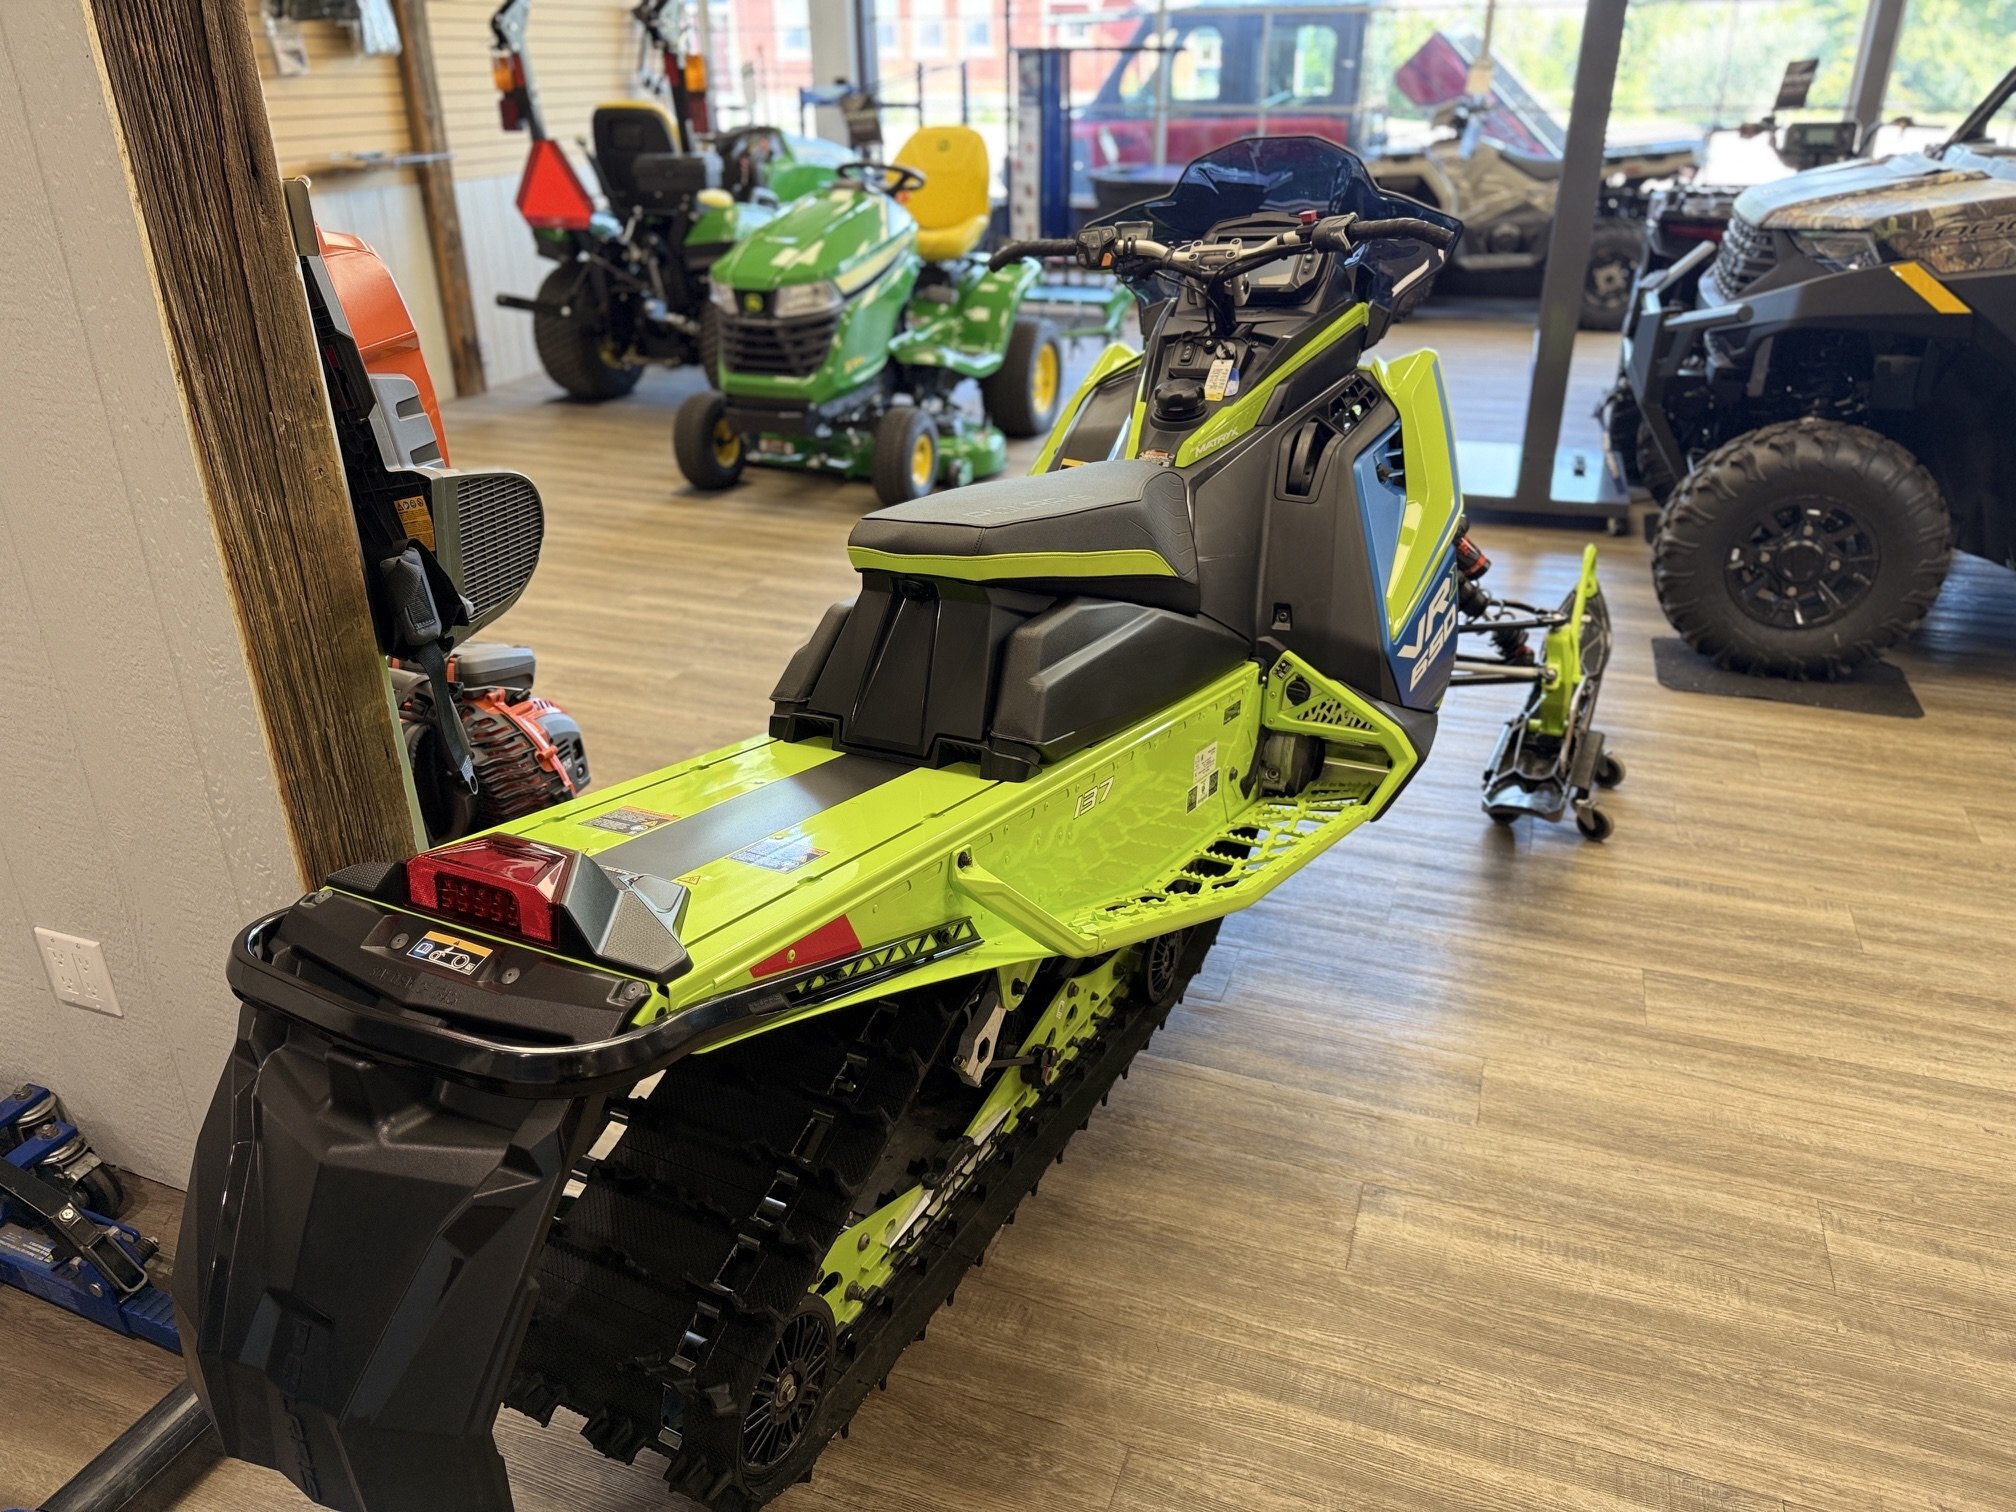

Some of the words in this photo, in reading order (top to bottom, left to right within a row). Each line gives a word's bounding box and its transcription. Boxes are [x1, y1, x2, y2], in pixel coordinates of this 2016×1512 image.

[1194, 426, 1239, 458] MATRYX
[961, 494, 1096, 519] POLARIS
[1409, 603, 1457, 693] 650
[1073, 775, 1115, 821] 137
